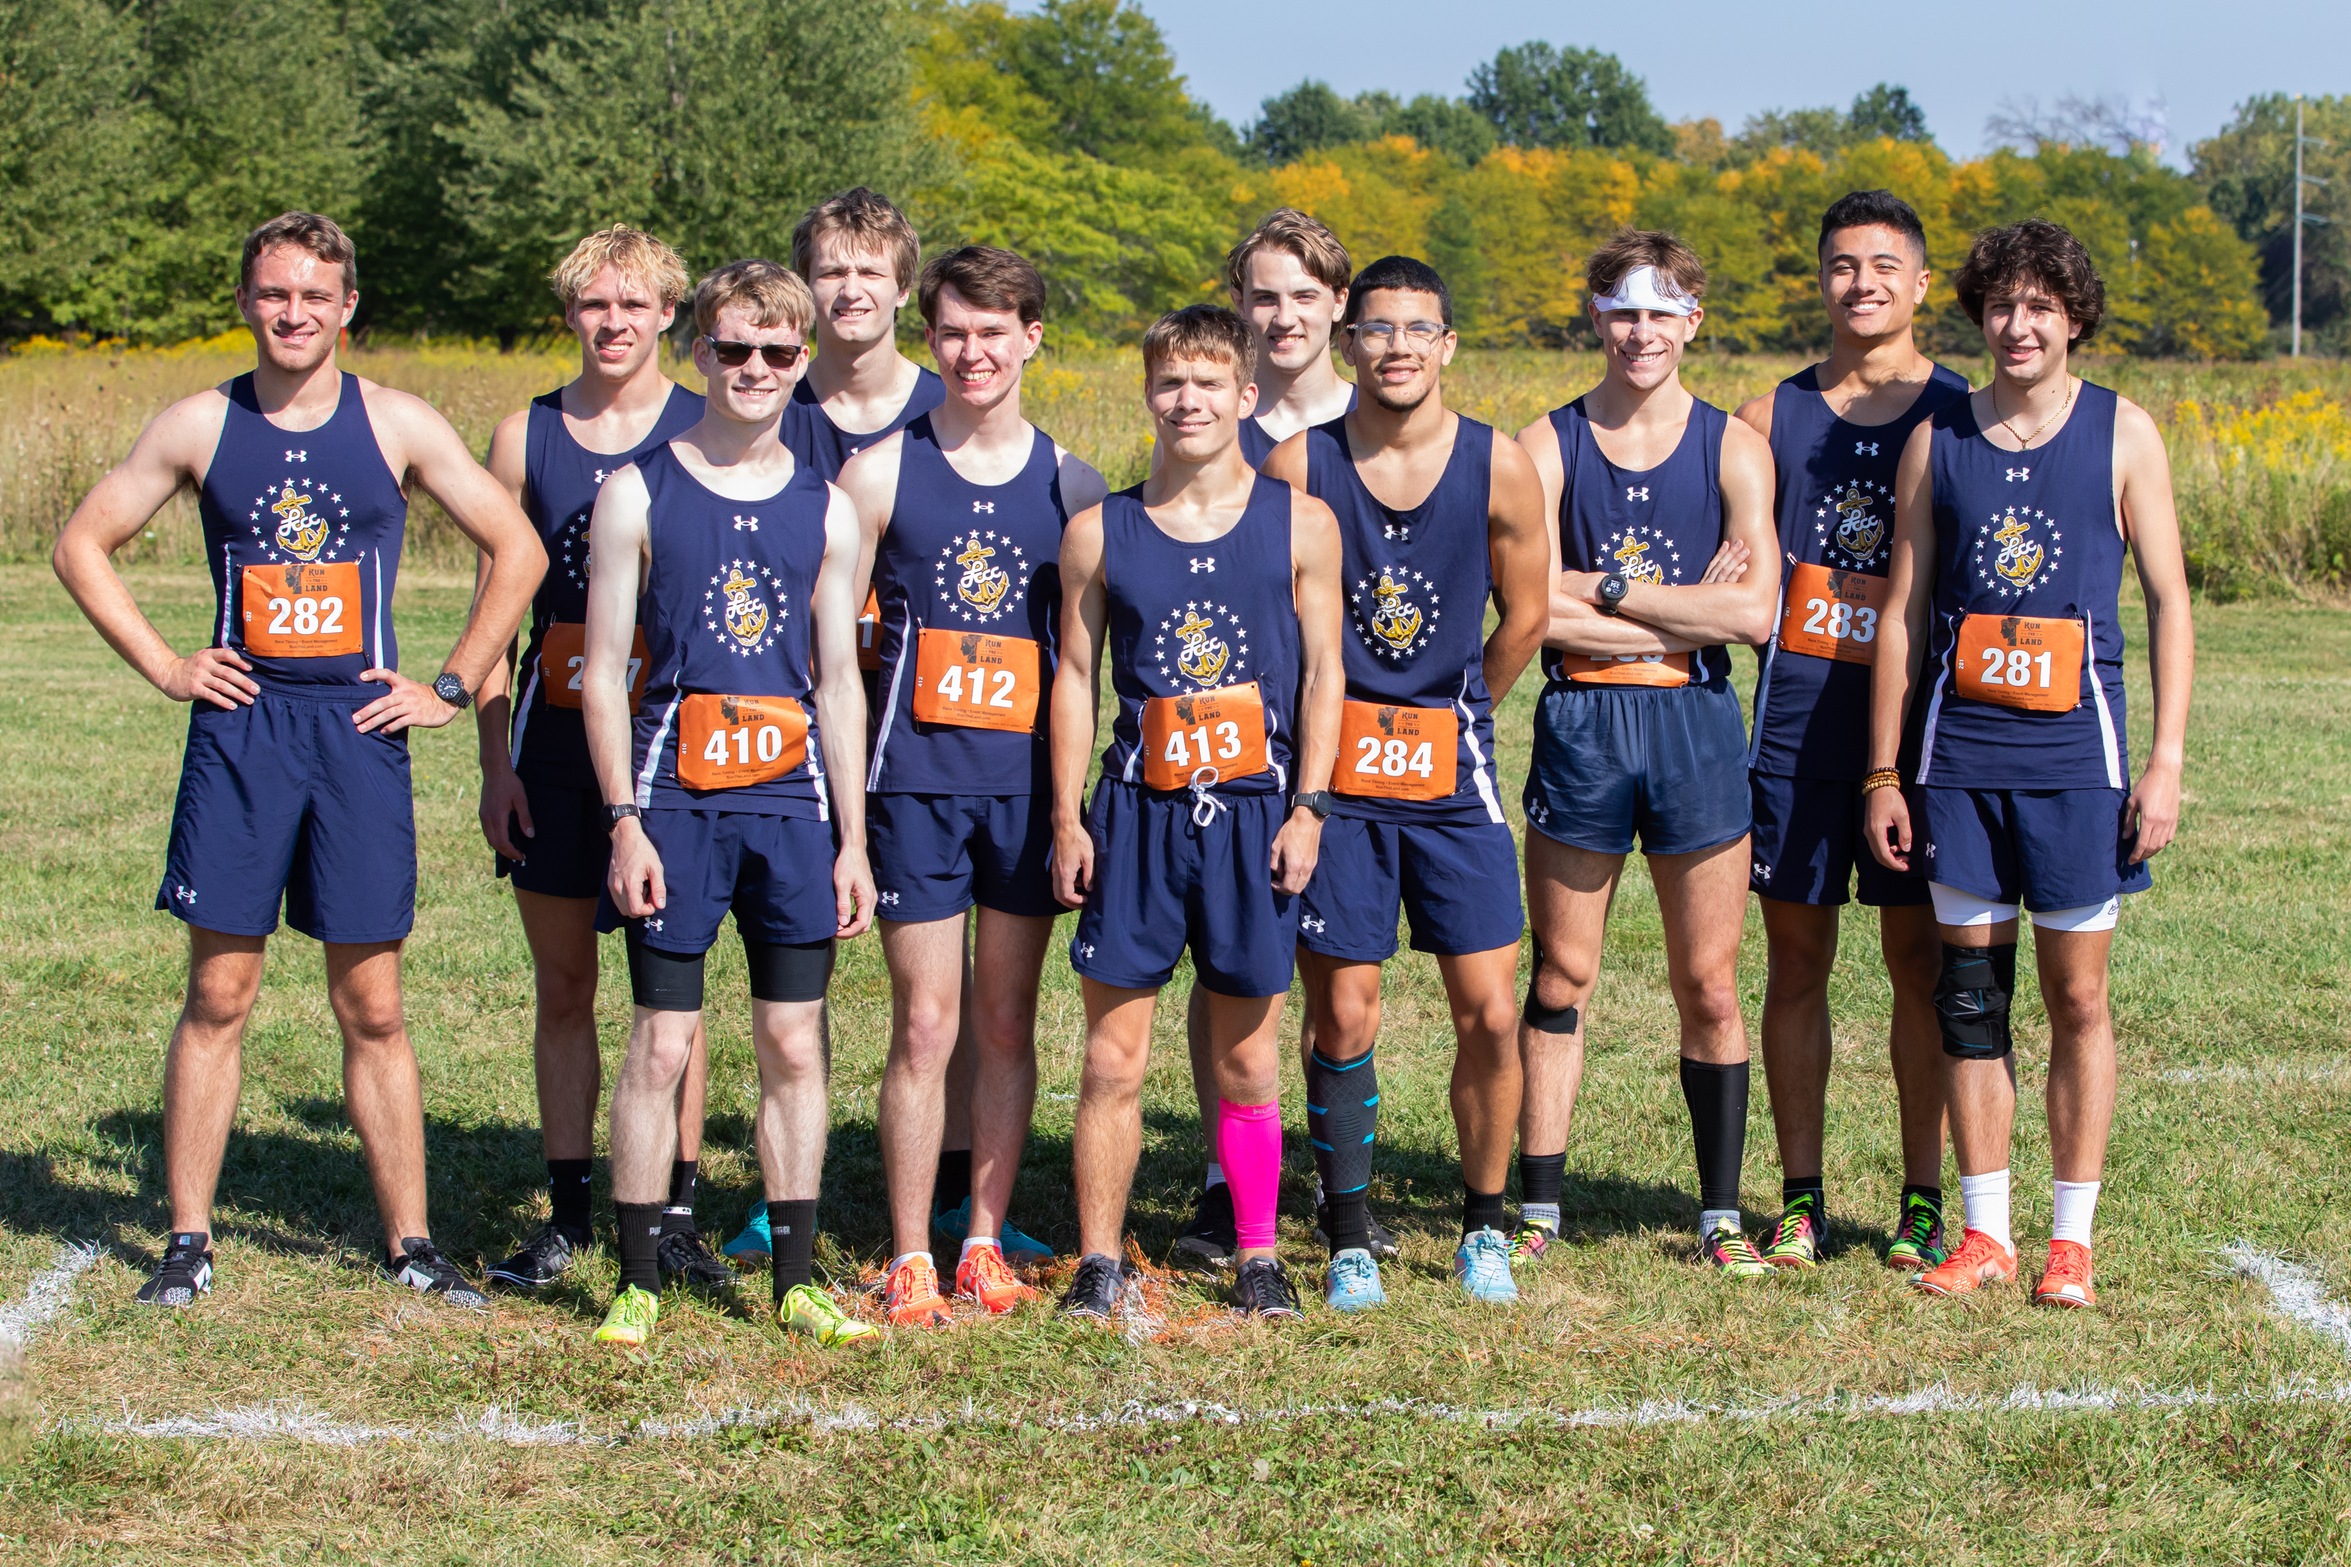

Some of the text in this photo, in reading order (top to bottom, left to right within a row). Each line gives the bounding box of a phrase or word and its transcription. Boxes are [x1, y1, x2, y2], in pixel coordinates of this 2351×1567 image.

[268, 596, 344, 634] 282
[1803, 598, 1878, 642] 283
[2024, 622, 2040, 630] RUN
[980, 656, 1002, 664] LAND
[985, 639, 1002, 648] RUN
[568, 656, 642, 692] 27
[937, 665, 1016, 708] 412
[1981, 647, 2052, 688] 281
[1198, 710, 1220, 721] LAND
[1398, 728, 1420, 736] LAND
[704, 725, 782, 766] 410
[1164, 721, 1242, 767] 413
[1355, 736, 1434, 778] 284
